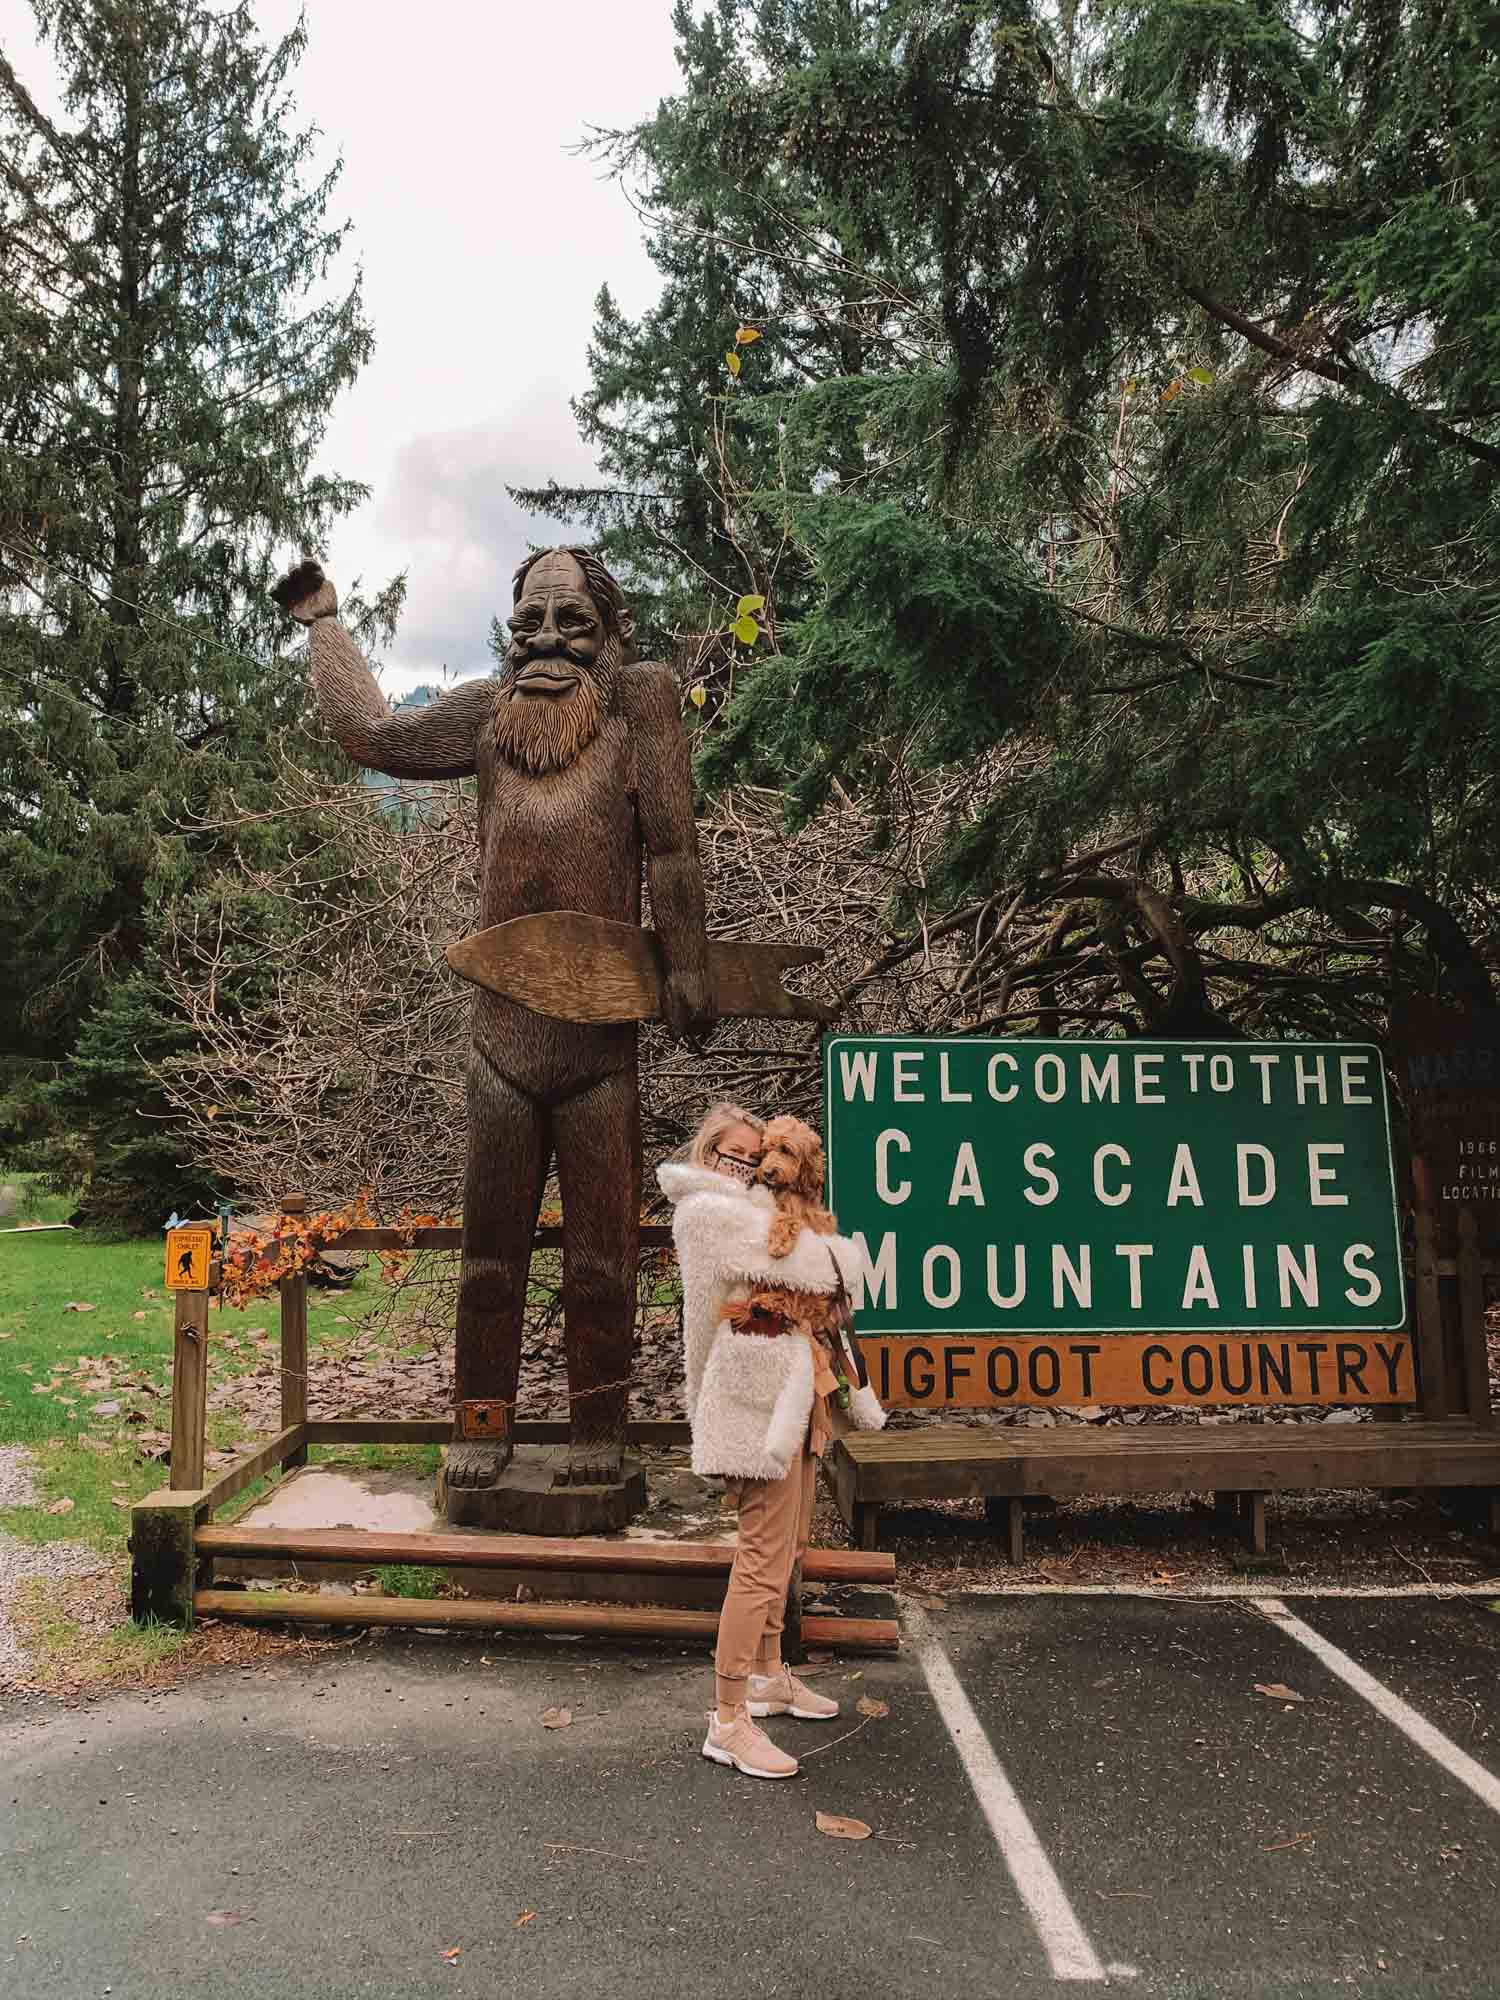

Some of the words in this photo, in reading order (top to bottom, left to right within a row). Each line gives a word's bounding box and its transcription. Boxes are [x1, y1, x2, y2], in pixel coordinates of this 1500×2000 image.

[839, 1052, 1166, 1104] WELCOME
[1181, 1054, 1234, 1092] TO
[1249, 1054, 1373, 1105] THE
[875, 1128, 1349, 1207] CASCADE
[1459, 1164, 1499, 1179] FILM
[852, 1231, 1382, 1310] MOUNTAINS
[860, 1345, 1101, 1400] IGFOOT
[1142, 1342, 1405, 1397] COUNTRY
